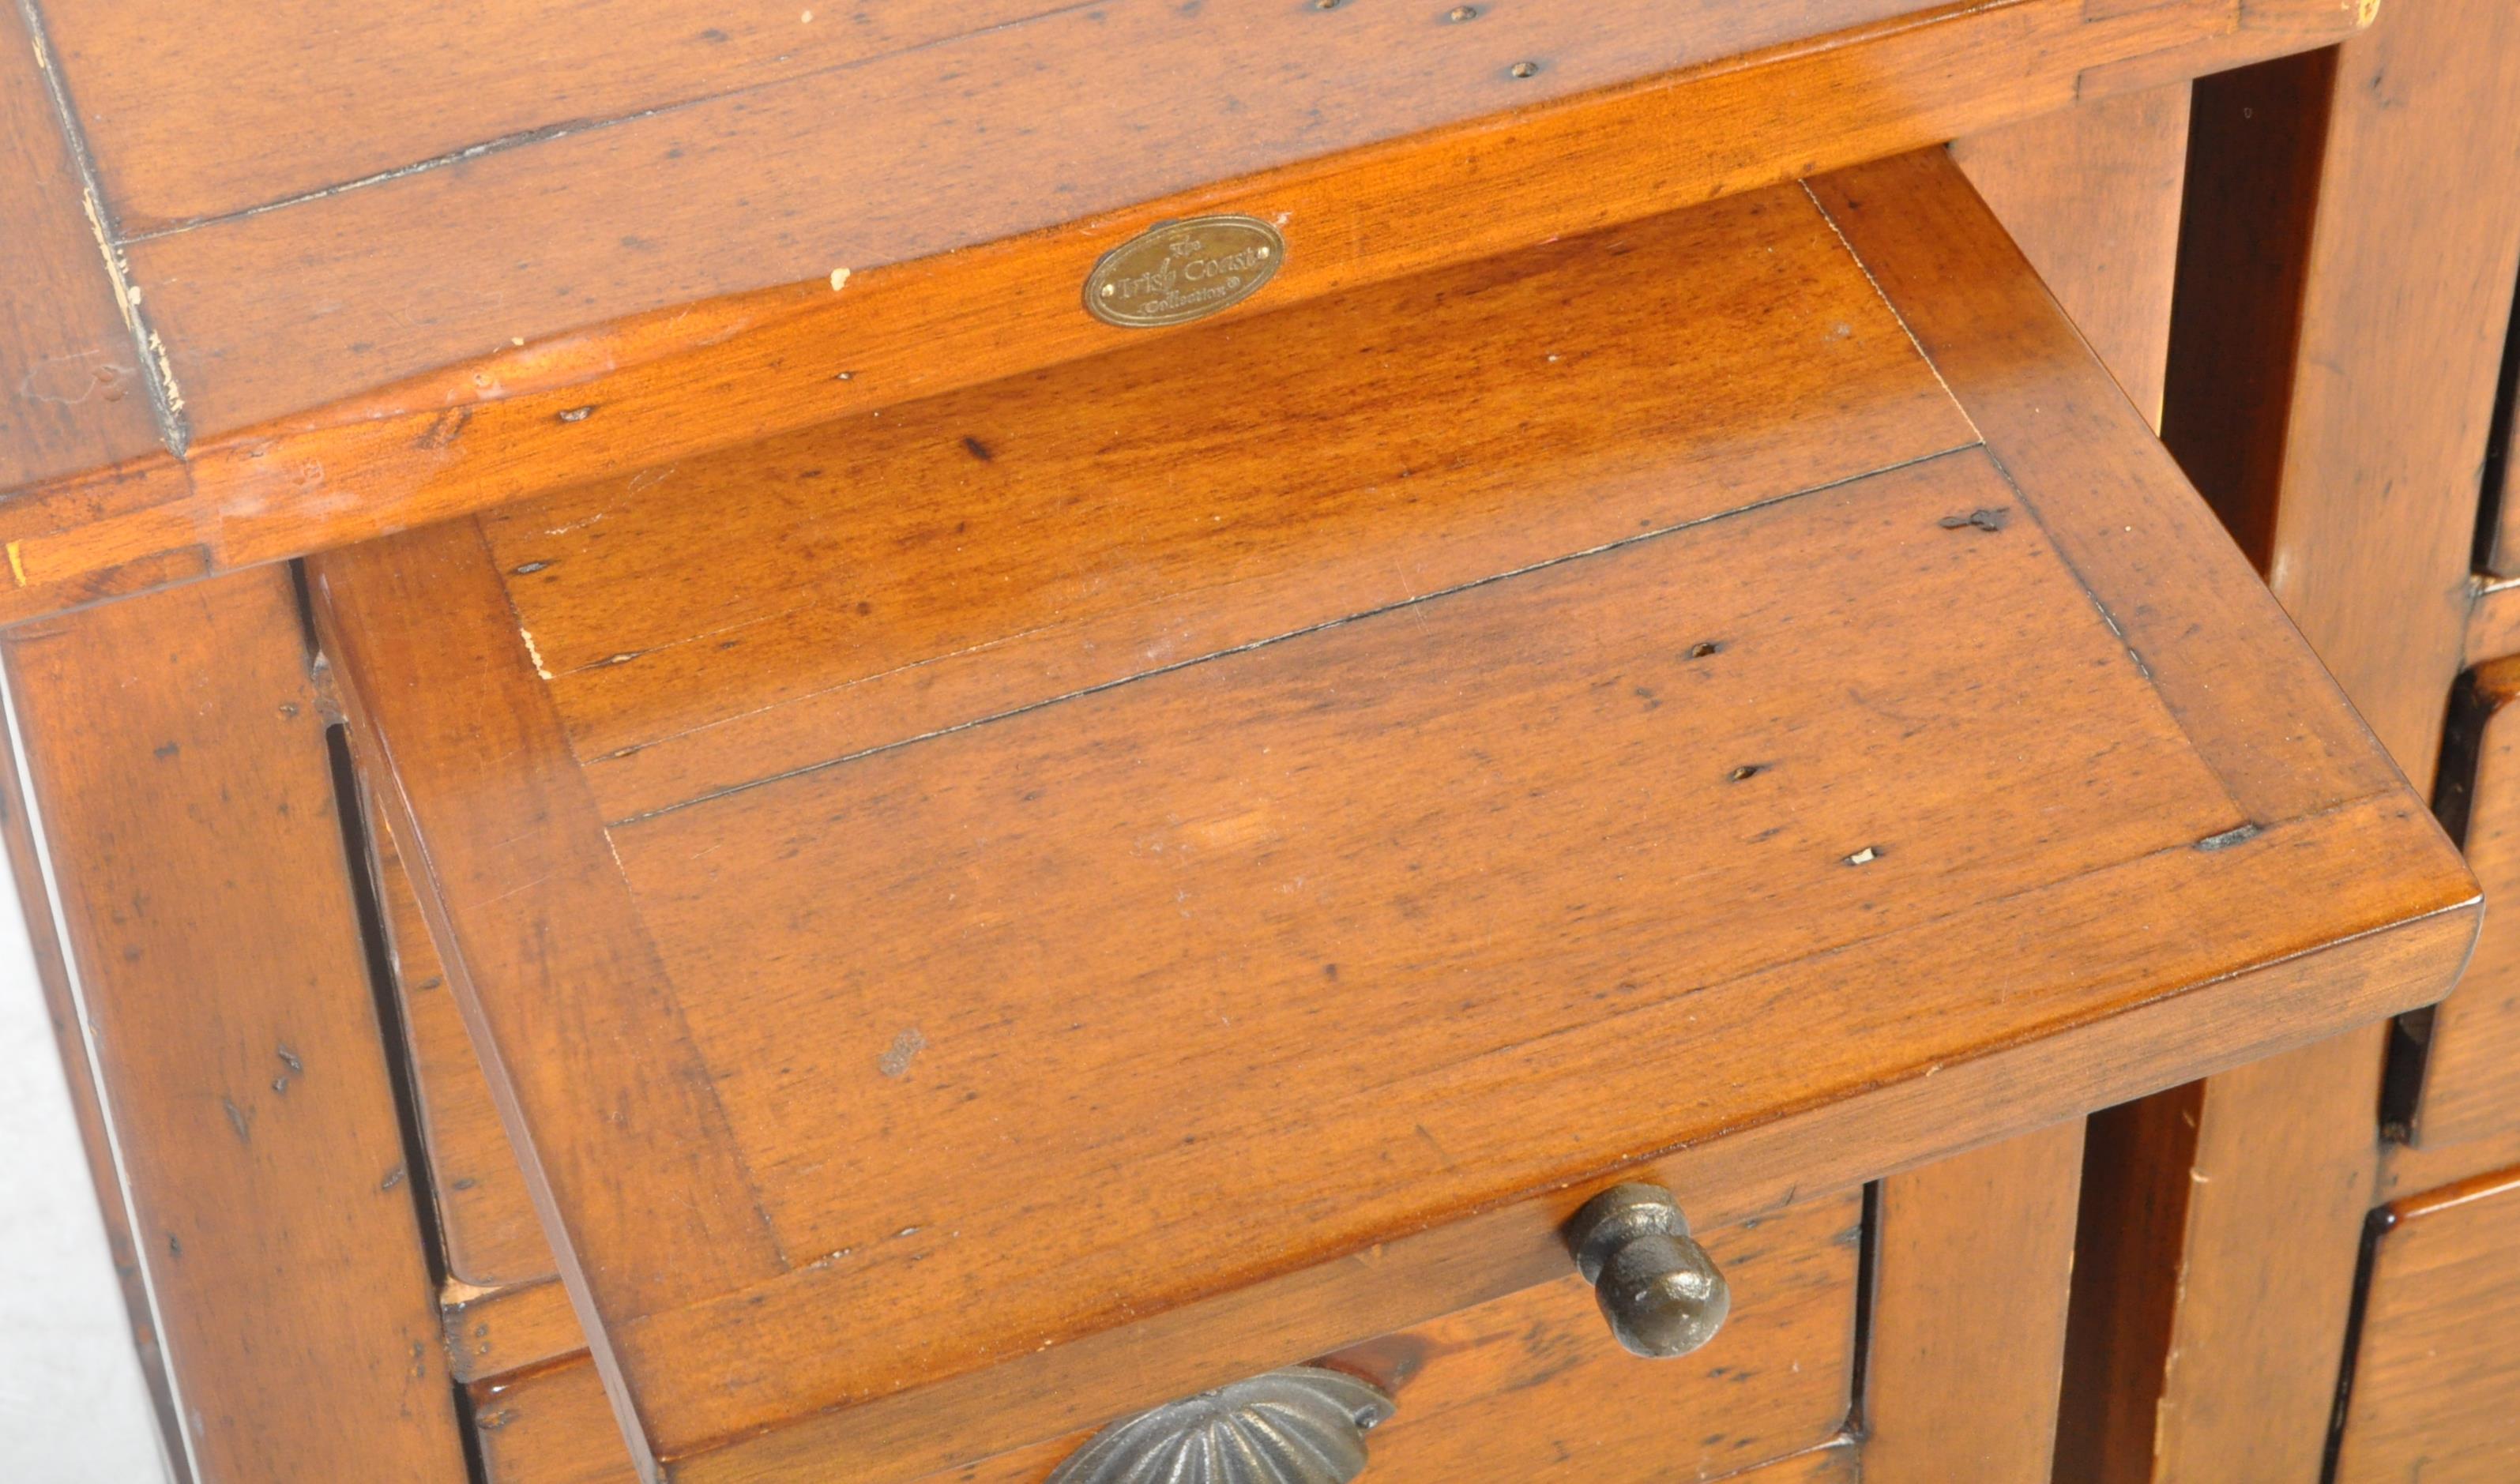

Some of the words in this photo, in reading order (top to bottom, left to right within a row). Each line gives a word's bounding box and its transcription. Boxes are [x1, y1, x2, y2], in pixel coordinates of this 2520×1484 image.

[1169, 235, 1201, 257] The
[1117, 257, 1176, 299] Irish
[1185, 247, 1256, 281] Coast
